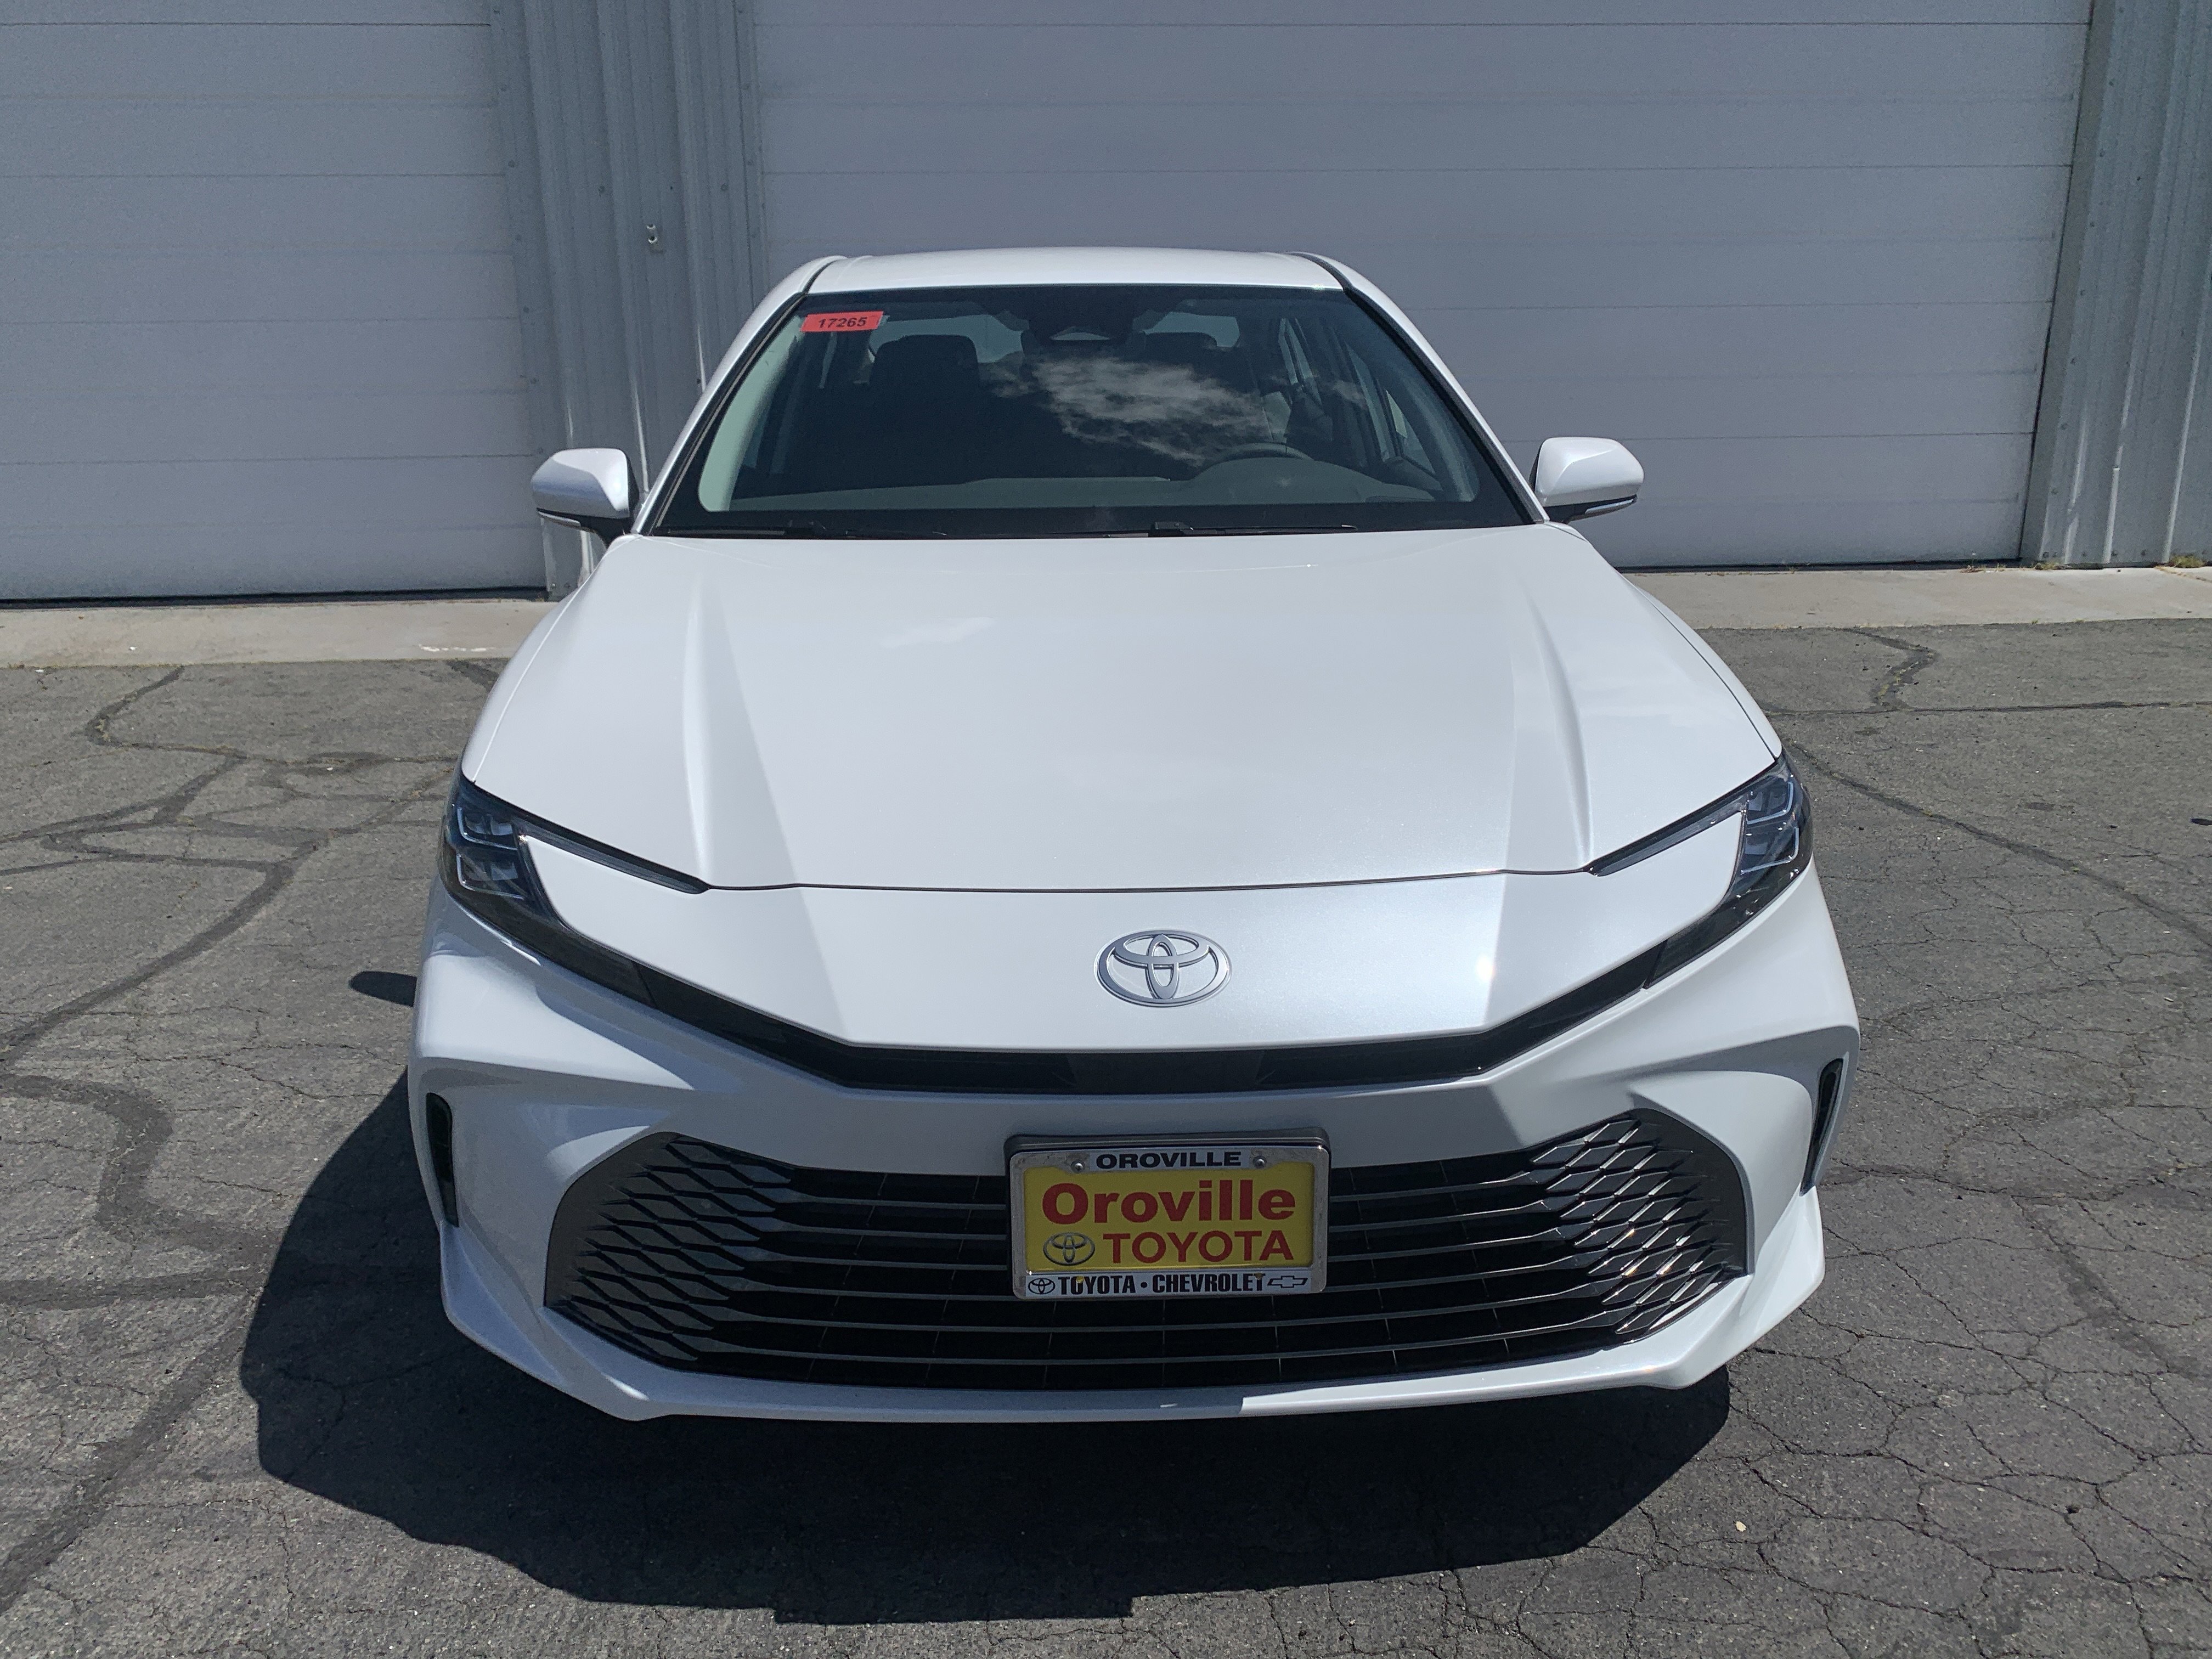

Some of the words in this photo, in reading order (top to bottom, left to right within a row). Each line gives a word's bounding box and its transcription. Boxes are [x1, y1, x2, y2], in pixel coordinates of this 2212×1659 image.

[819, 317, 867, 328] 17265
[1096, 1152, 1242, 1169] OROVILLE
[1042, 1180, 1296, 1224] Oroville
[1103, 1230, 1294, 1263] TOYOTA
[1058, 1274, 1138, 1295] TOYOTA
[1152, 1273, 1266, 1293] CHEVROLET
